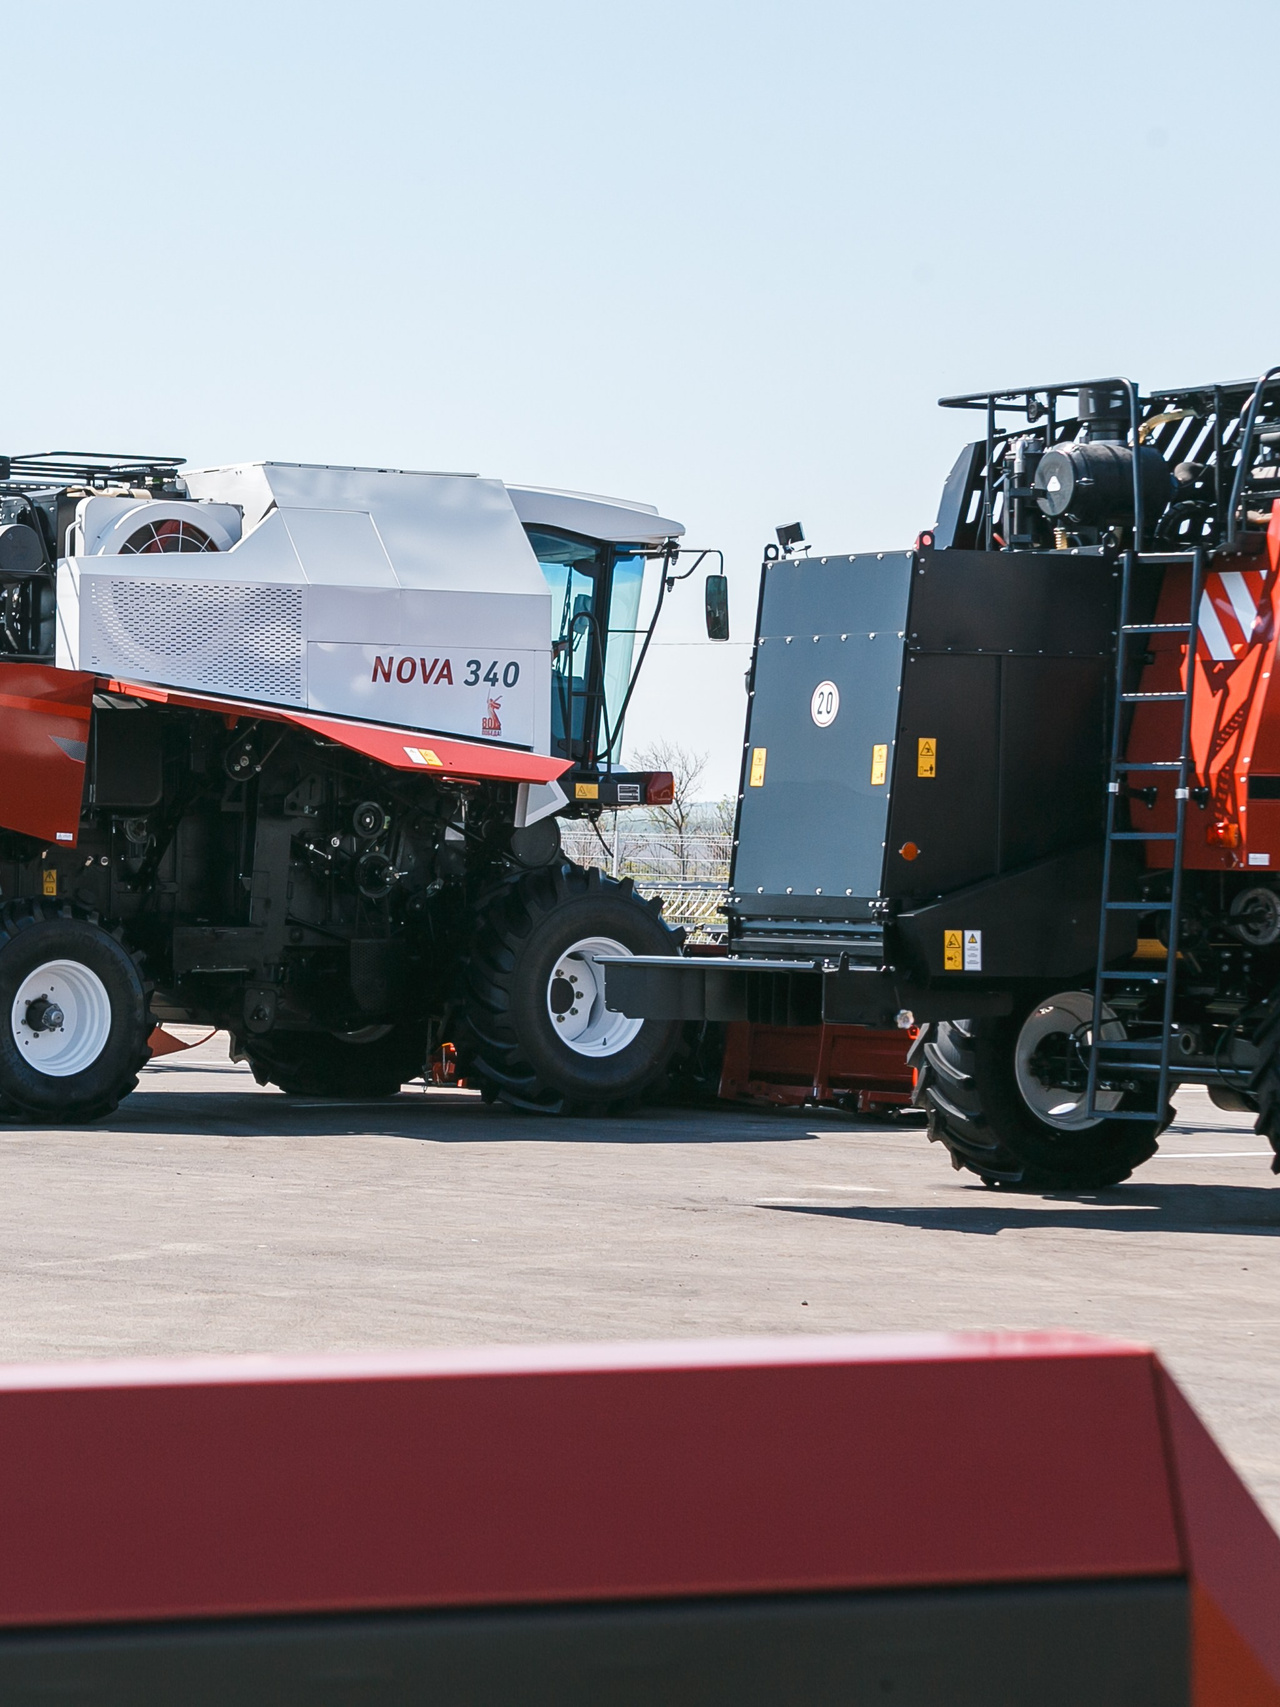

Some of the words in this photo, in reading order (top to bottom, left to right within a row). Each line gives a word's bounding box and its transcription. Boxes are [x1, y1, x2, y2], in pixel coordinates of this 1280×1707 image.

[371, 655, 454, 686] NOVA
[463, 659, 520, 688] 340
[816, 691, 834, 715] 20
[481, 717, 493, 729] 80
